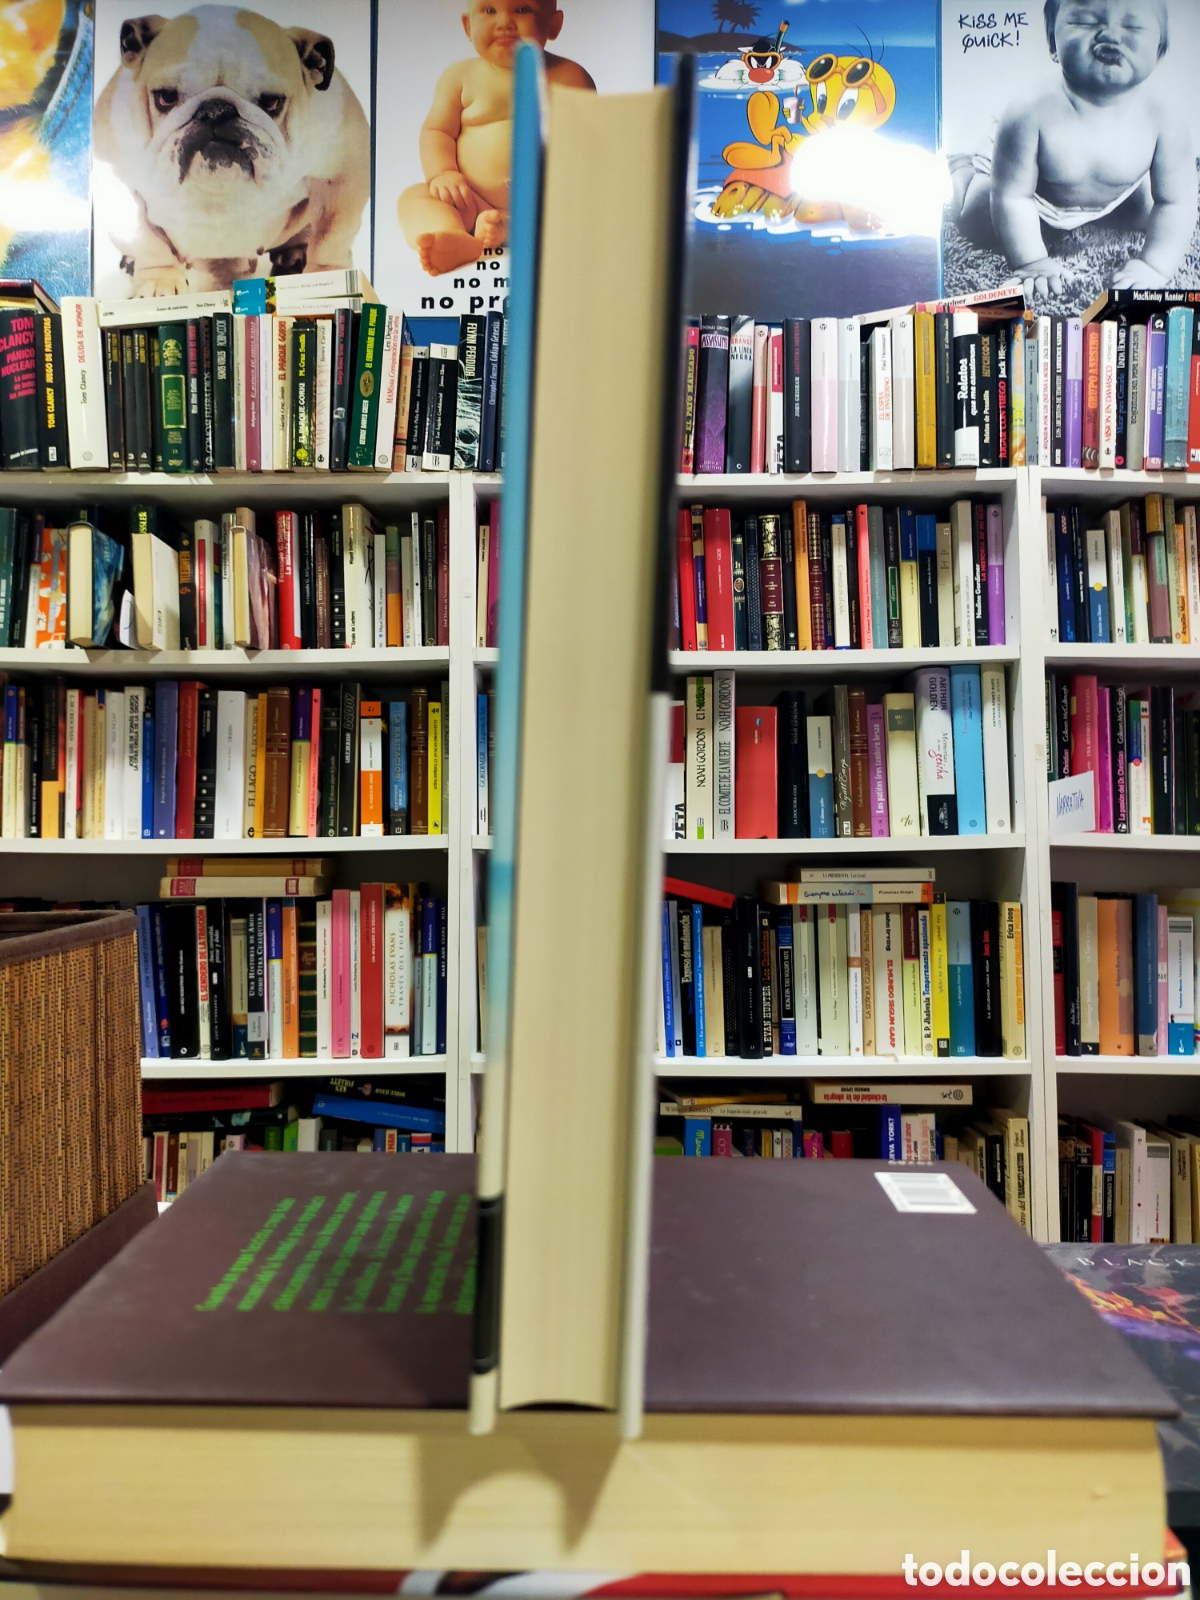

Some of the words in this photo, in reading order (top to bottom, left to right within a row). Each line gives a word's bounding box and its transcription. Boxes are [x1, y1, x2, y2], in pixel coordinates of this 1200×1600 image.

[1003, 12, 1028, 28] ME
[484, 247, 504, 256] no
[477, 261, 500, 271] no
[453, 277, 480, 289] no
[421, 296, 454, 309] no
[973, 287, 1018, 303] GOLDENEYE
[1133, 290, 1163, 303] MacKinlay
[10, 316, 34, 332] TOM
[75, 303, 83, 328] HONOR
[43, 317, 52, 352] PATRIOTAS
[76, 329, 84, 338] DE
[277, 321, 286, 342] GORKI
[367, 327, 376, 337] DEL
[385, 315, 393, 340] Deighton
[466, 322, 477, 345] FLYNN
[491, 321, 500, 343] Génesis
[0, 332, 35, 353] CLANCY
[77, 341, 86, 363] DEUDA
[490, 342, 499, 363] Código
[1088, 331, 1099, 375] ASESINO
[44, 353, 53, 362] DE
[278, 343, 286, 371] PARQUE
[388, 341, 397, 379] Conspiración
[465, 345, 477, 377] PERDIDA
[731, 354, 752, 362] NEGRA
[969, 343, 977, 386] asustaron
[981, 335, 991, 378] HITCHCOCK
[1117, 351, 1126, 369] LINDA
[1, 358, 36, 378] NUCLEAR
[44, 363, 54, 383] JUEGO
[687, 349, 695, 393] MAREADO
[998, 360, 1007, 379] Jack
[79, 369, 88, 390] Clancy
[956, 358, 969, 401] Relatos
[46, 387, 55, 412] CLANCY
[298, 382, 306, 405] GORKI
[386, 378, 395, 405] MAMista
[970, 386, 977, 400] me
[999, 380, 1007, 409] FUEGO
[1087, 375, 1098, 409] GRUPO
[969, 399, 978, 416] que
[1105, 404, 1112, 414] EN
[47, 413, 56, 429] TOM
[298, 405, 306, 434] PARQUE
[983, 415, 990, 423] de
[285, 566, 291, 575] La
[980, 571, 986, 581] LA
[719, 677, 731, 710] GORDON
[928, 677, 938, 711] GOLDEN
[939, 676, 948, 711] ARTHUR
[1061, 685, 1070, 720] McCullough
[1116, 687, 1125, 721] McCullough
[134, 714, 139, 722] LA
[343, 692, 355, 730] DADDY
[719, 709, 731, 732] NOAH
[134, 722, 139, 730] DE
[1116, 721, 1125, 744] Colleen
[696, 727, 706, 765] GORDON
[718, 740, 731, 763] MUERTE
[1062, 748, 1070, 774] Christian
[1117, 750, 1125, 776] Christian
[696, 764, 706, 788] NOAH
[839, 780, 852, 811] Wyatt
[875, 780, 884, 802] patitos
[1117, 784, 1125, 794] del
[719, 804, 731, 815] EL
[876, 802, 884, 813] Los
[1118, 793, 1126, 813] pasión
[1118, 812, 1125, 821] La
[804, 890, 831, 900] Siempre
[831, 888, 855, 898] estarás
[197, 909, 207, 941] TRAICIÓN
[1006, 907, 1014, 923] Jong
[248, 935, 255, 944] DE
[256, 912, 264, 956] CUALQUIERA
[397, 920, 405, 950] FUEGO
[680, 914, 692, 950] medianoche
[920, 914, 929, 950] apasionado
[1006, 923, 1014, 939] Erica
[198, 940, 206, 950] LA
[198, 949, 207, 960] DE
[388, 931, 396, 958] EVANS
[681, 958, 693, 983] Expreso
[762, 967, 770, 981] Los
[886, 959, 894, 969] EL
[921, 950, 930, 996] Temperamento
[1015, 966, 1022, 976] DE
[199, 960, 208, 993] SENDERO
[389, 960, 397, 1005] NICHOLAS
[201, 994, 208, 1002] EL
[762, 985, 771, 1018] HUNTER
[1016, 998, 1024, 1025] CANCIÓN
[763, 1020, 772, 1043] EVAN
[888, 1026, 896, 1049] GARP
[924, 1031, 931, 1039] R.
[330, 1077, 354, 1088] FOLLETT
[823, 1093, 844, 1103] alegría
[845, 1093, 852, 1102] la
[853, 1094, 861, 1102] de
[862, 1093, 881, 1102] ciudad
[881, 1094, 888, 1102] la
